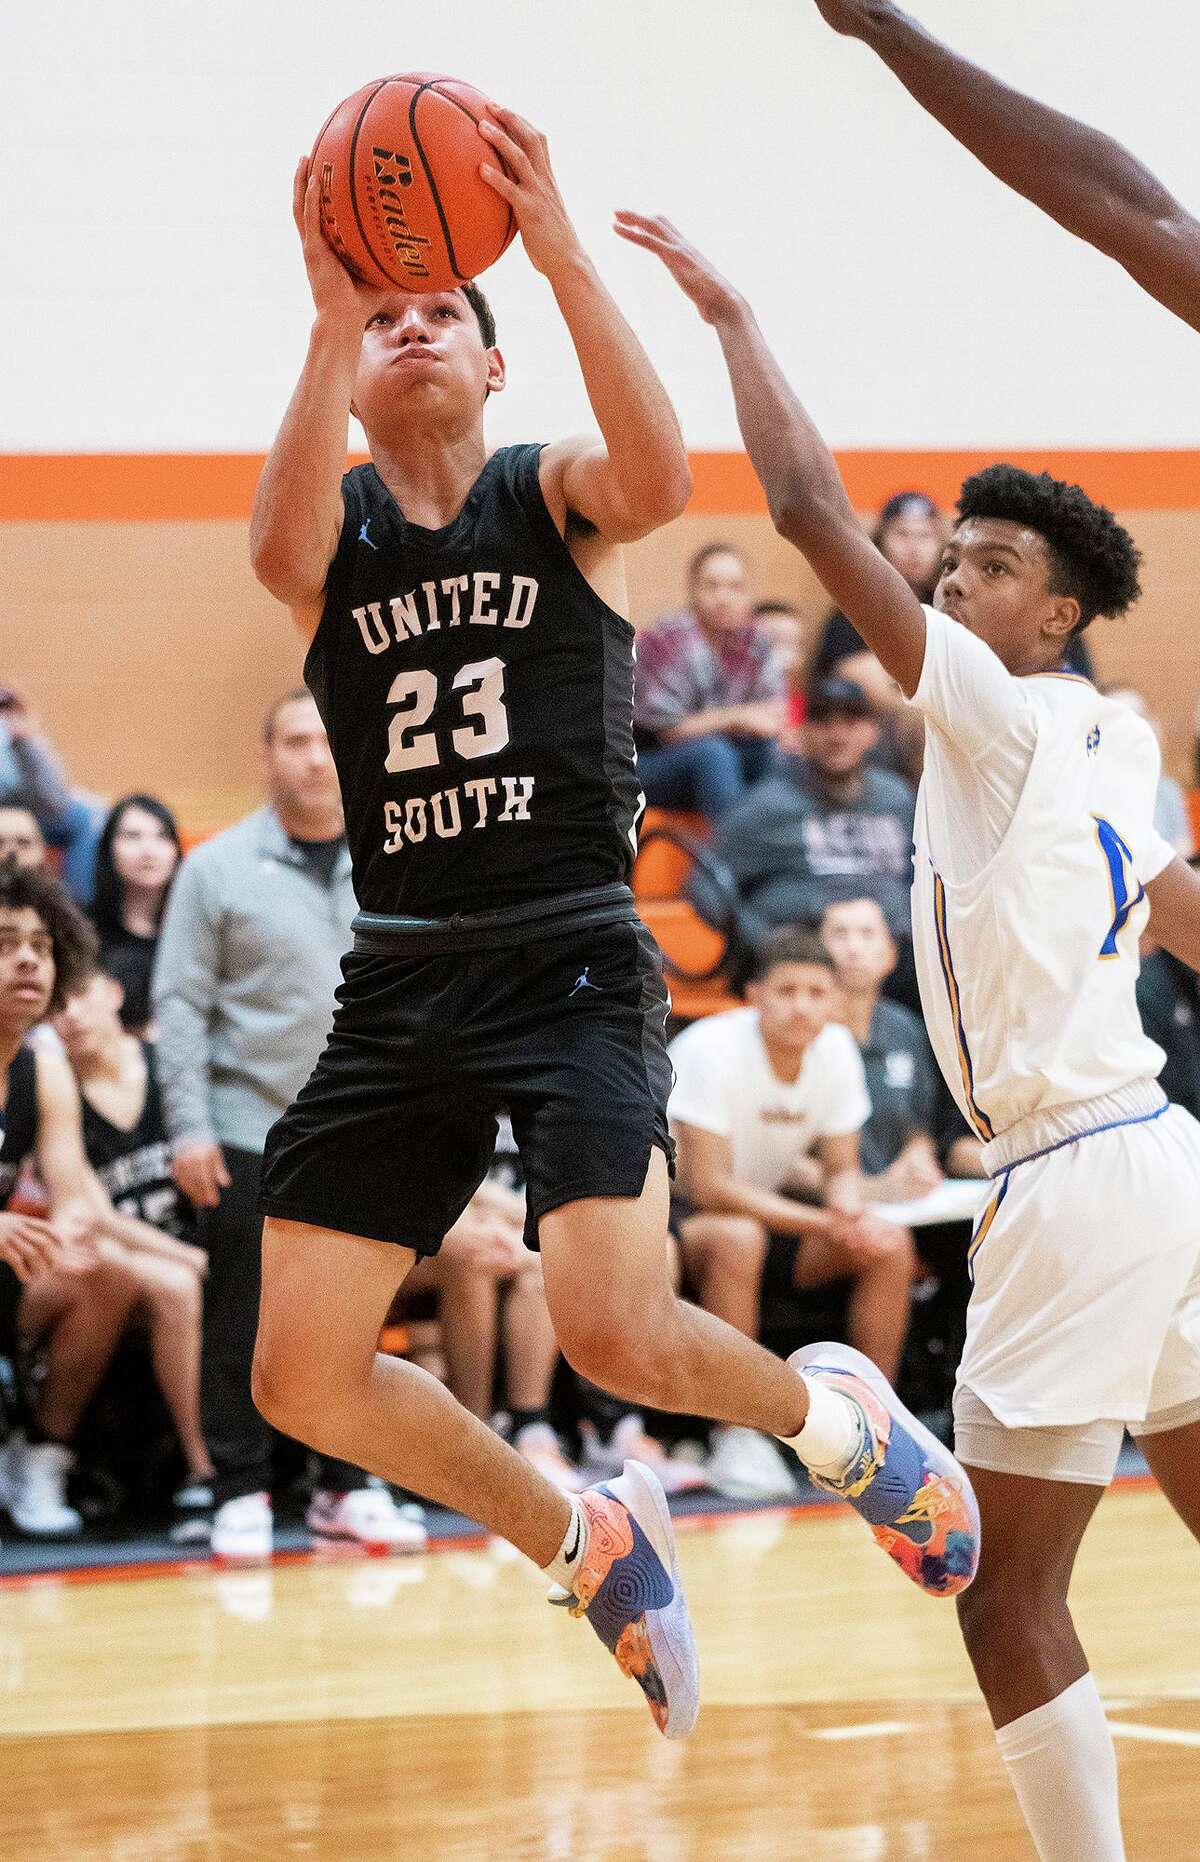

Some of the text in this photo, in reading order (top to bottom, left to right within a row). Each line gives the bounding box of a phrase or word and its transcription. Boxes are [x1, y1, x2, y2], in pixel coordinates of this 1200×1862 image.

[372, 146, 432, 278] Baden
[352, 572, 539, 655] UNITED
[384, 656, 511, 774] 23
[383, 776, 535, 854] SOUTH
